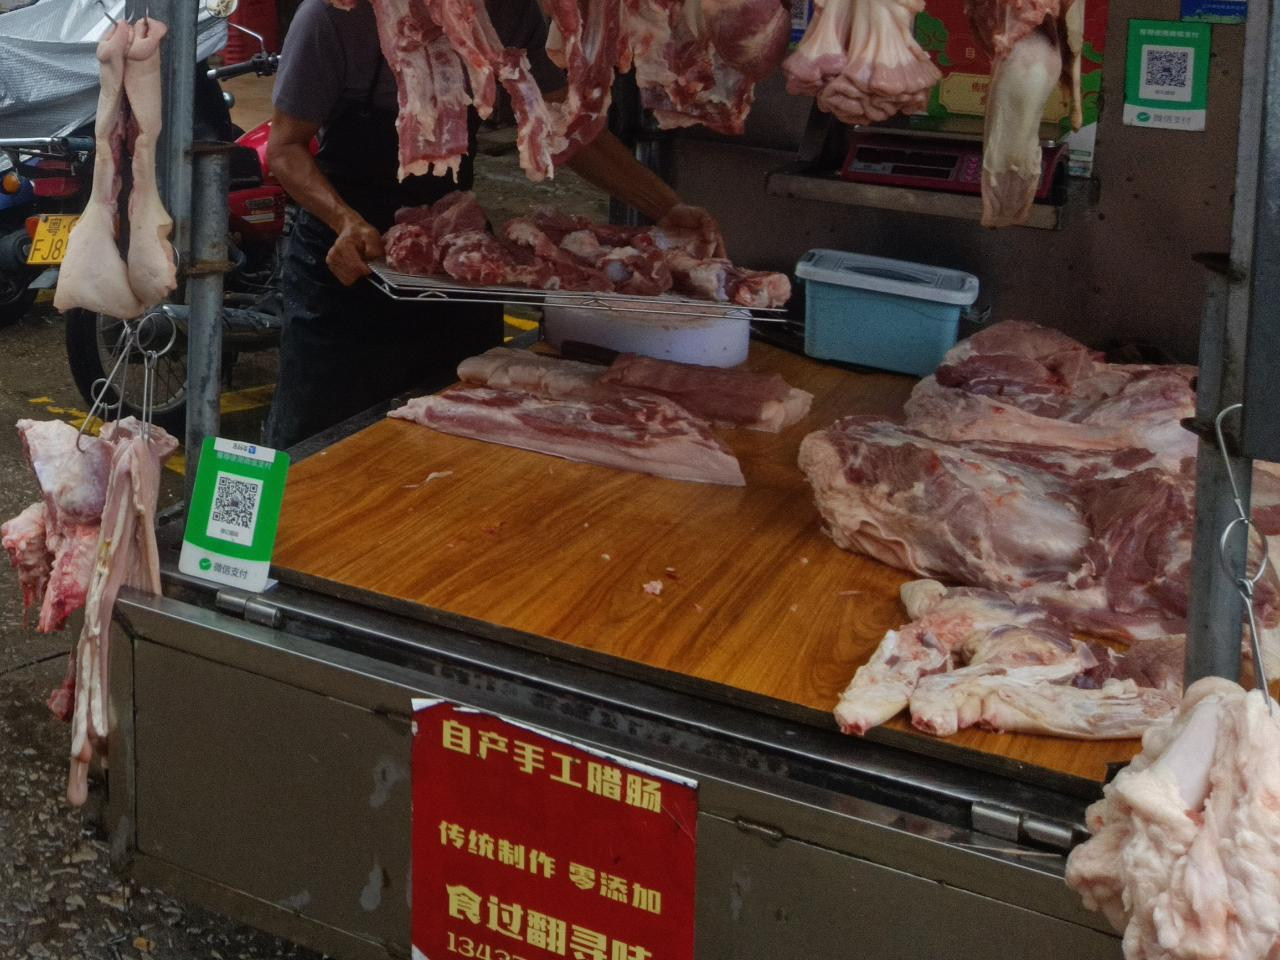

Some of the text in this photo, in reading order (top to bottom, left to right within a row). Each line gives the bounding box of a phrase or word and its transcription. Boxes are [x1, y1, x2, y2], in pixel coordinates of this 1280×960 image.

[30, 238, 69, 261] FJ8
[442, 719, 662, 813] 自产手工腊肠
[438, 820, 662, 915] 传统制作 零添加
[446, 931, 528, 960] 1343
